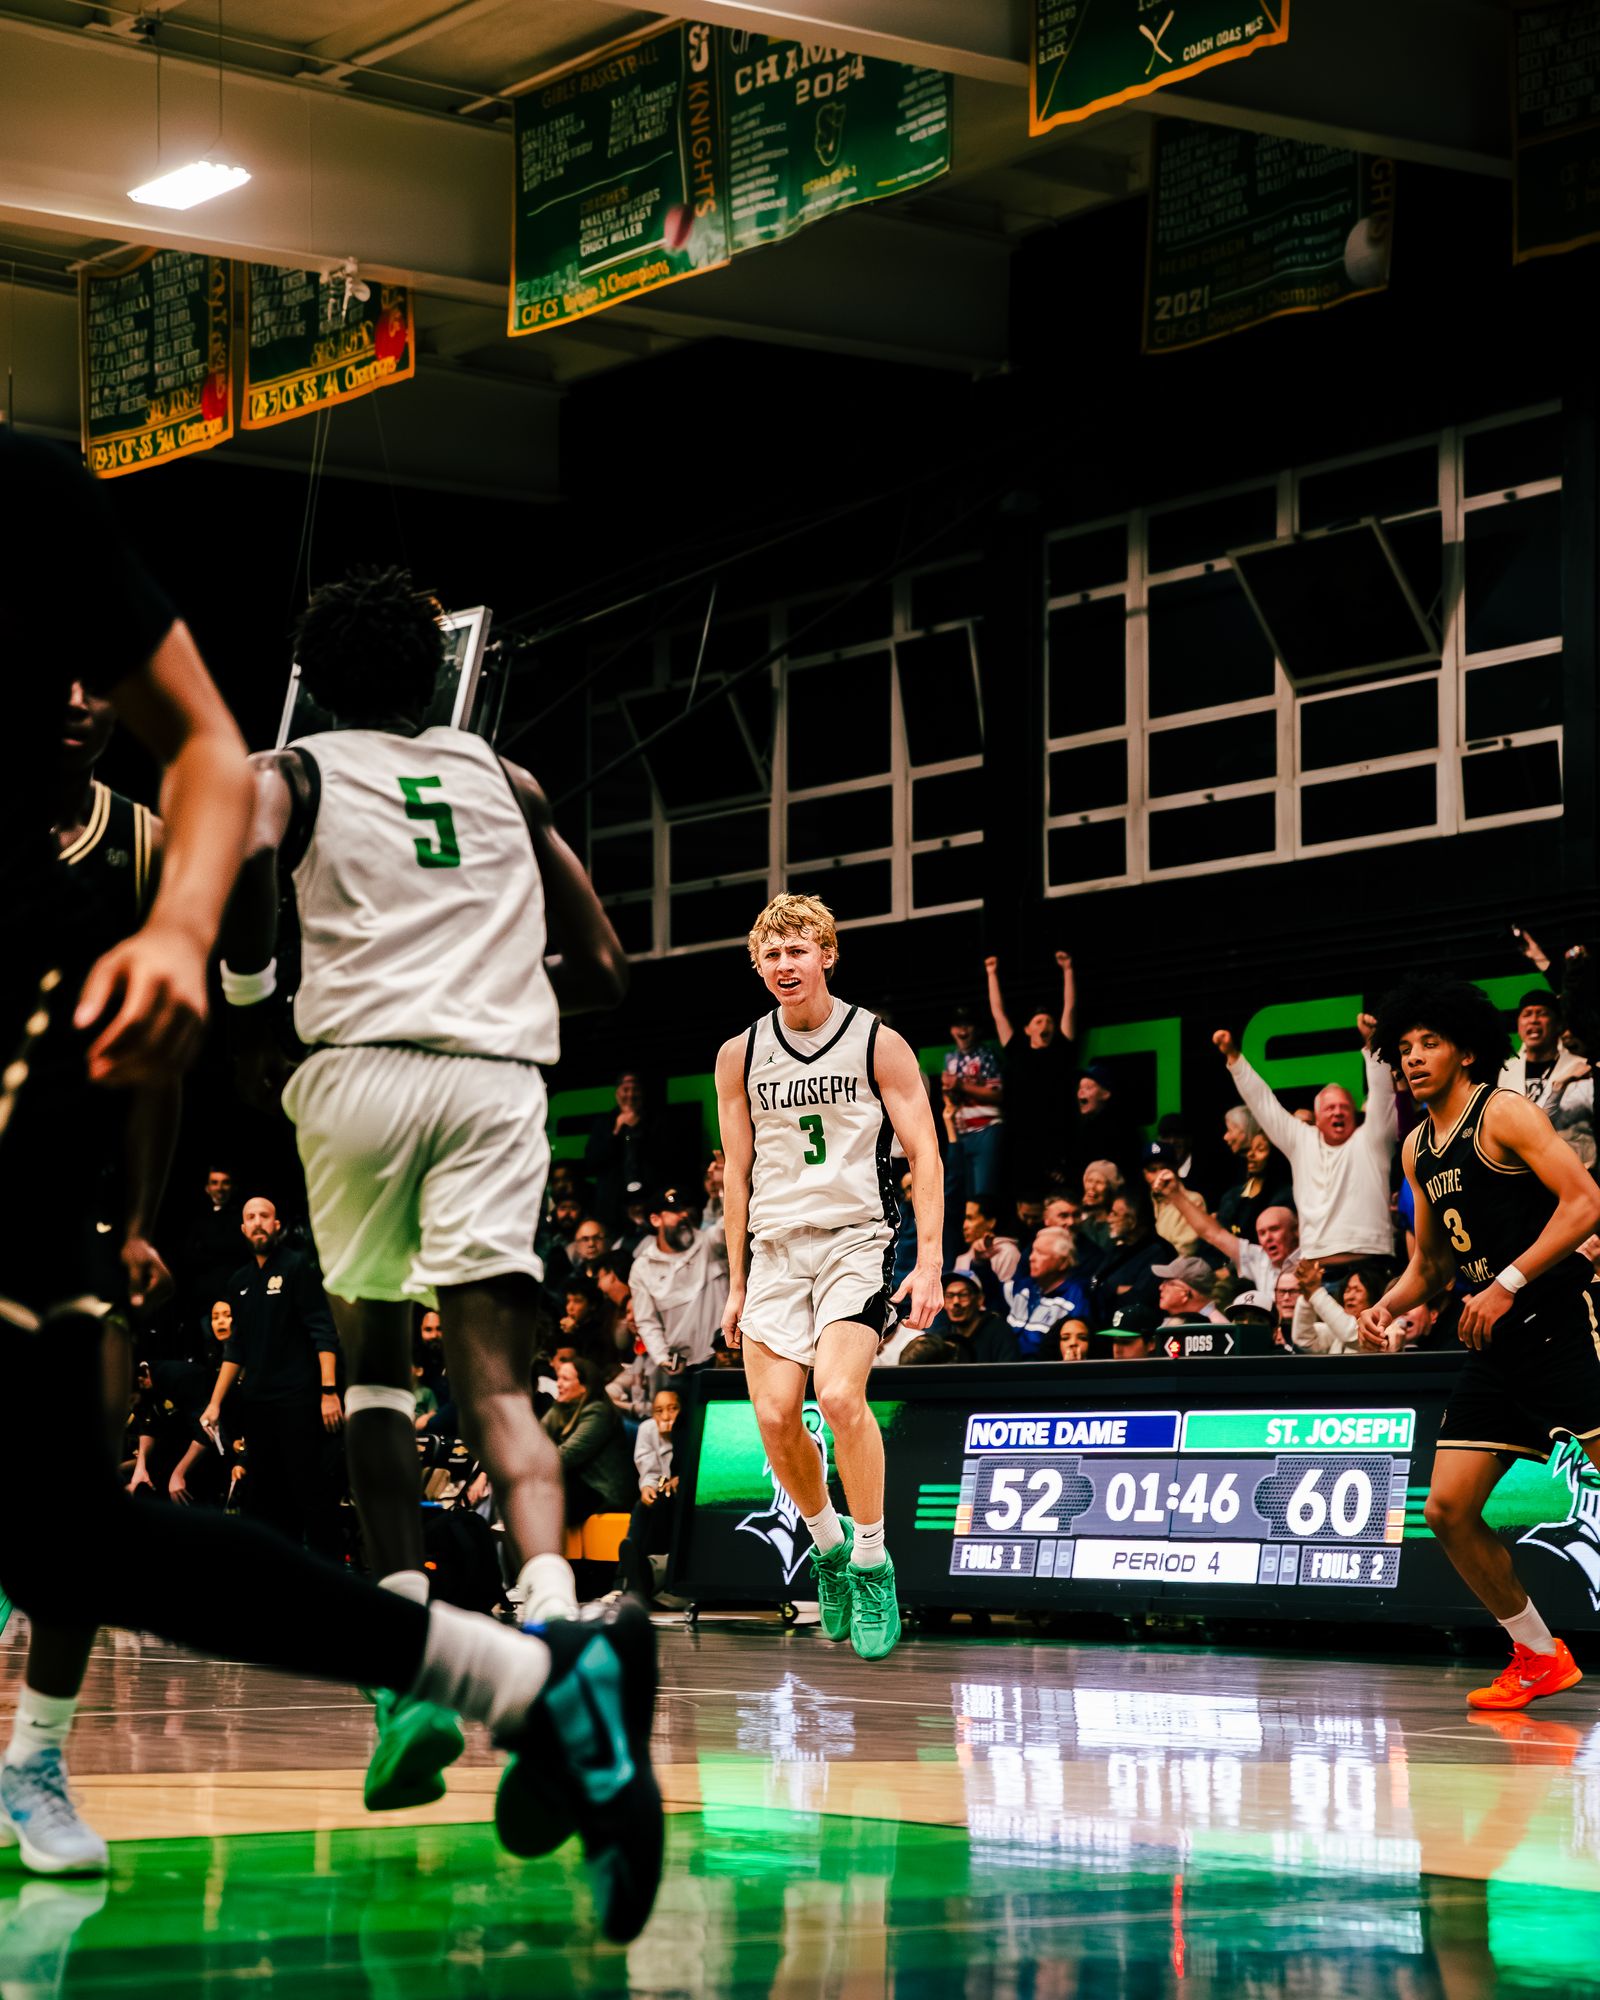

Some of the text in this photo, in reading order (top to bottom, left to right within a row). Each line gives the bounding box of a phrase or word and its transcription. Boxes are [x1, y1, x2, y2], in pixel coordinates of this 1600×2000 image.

[1183, 36, 1213, 62] COACH
[735, 42, 847, 96] CHAM
[795, 56, 865, 105] 2024
[541, 78, 577, 110] GIRLS
[688, 80, 718, 219] KNIGHTS
[580, 236, 609, 257] CHUCK
[607, 261, 670, 293] Champions
[1153, 283, 1211, 321] 2021
[396, 775, 461, 869] 5
[799, 1114, 827, 1165] 3
[1426, 1168, 1463, 1204] NOTRE
[1443, 1208, 1472, 1252] 3
[971, 1420, 1128, 1446] NOTRE DAME
[1265, 1417, 1410, 1444] ST. JOSEPH
[984, 1468, 1066, 1532] 52
[1104, 1472, 1241, 1524] 01:46
[1286, 1469, 1374, 1537] 60
[960, 1544, 1022, 1570] FOULS 1
[1112, 1551, 1220, 1576] PERIOD 4
[1311, 1552, 1384, 1580] FOULS 2
